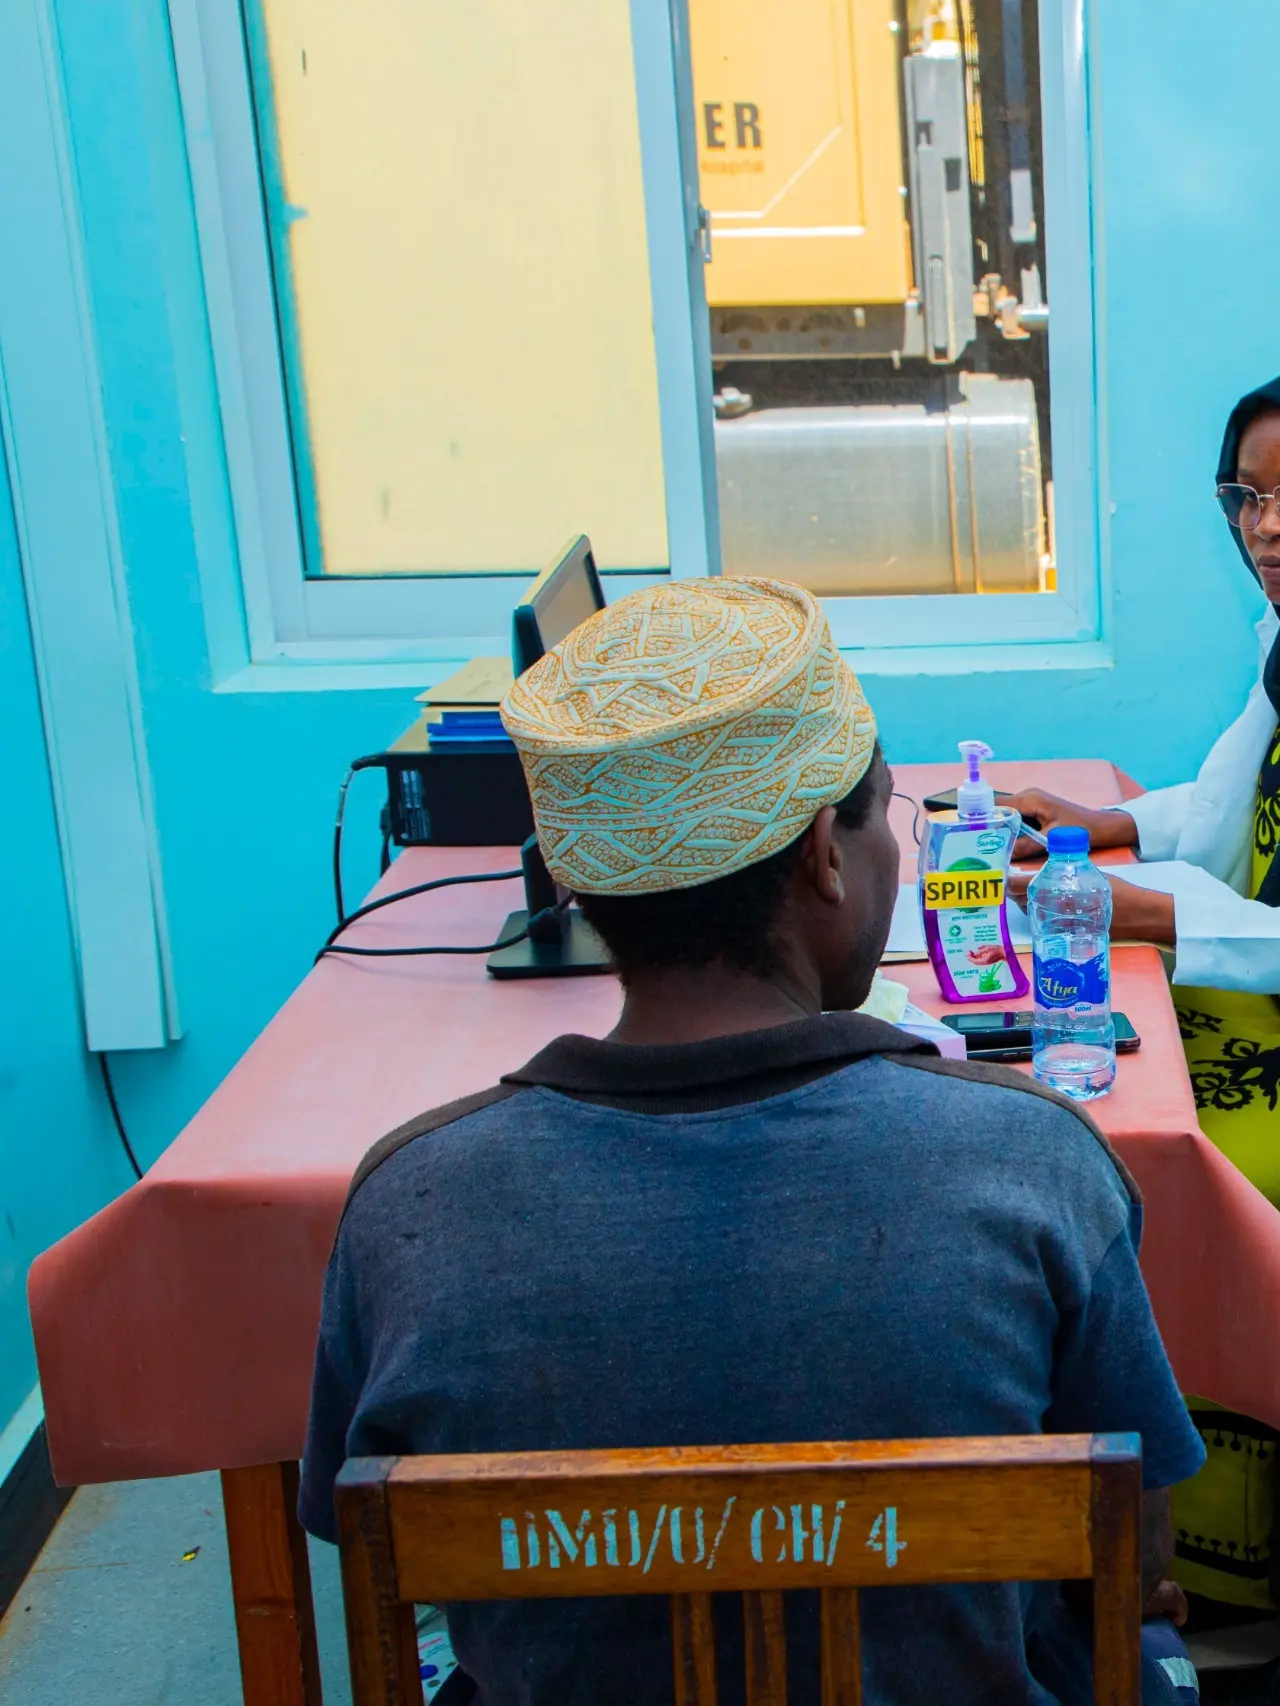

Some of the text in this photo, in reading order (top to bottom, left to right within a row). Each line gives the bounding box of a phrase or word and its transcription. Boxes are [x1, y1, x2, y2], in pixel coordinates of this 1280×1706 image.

[704, 103, 762, 148] ER
[926, 879, 1003, 901] SPIRIT
[865, 1506, 908, 1568] 4
